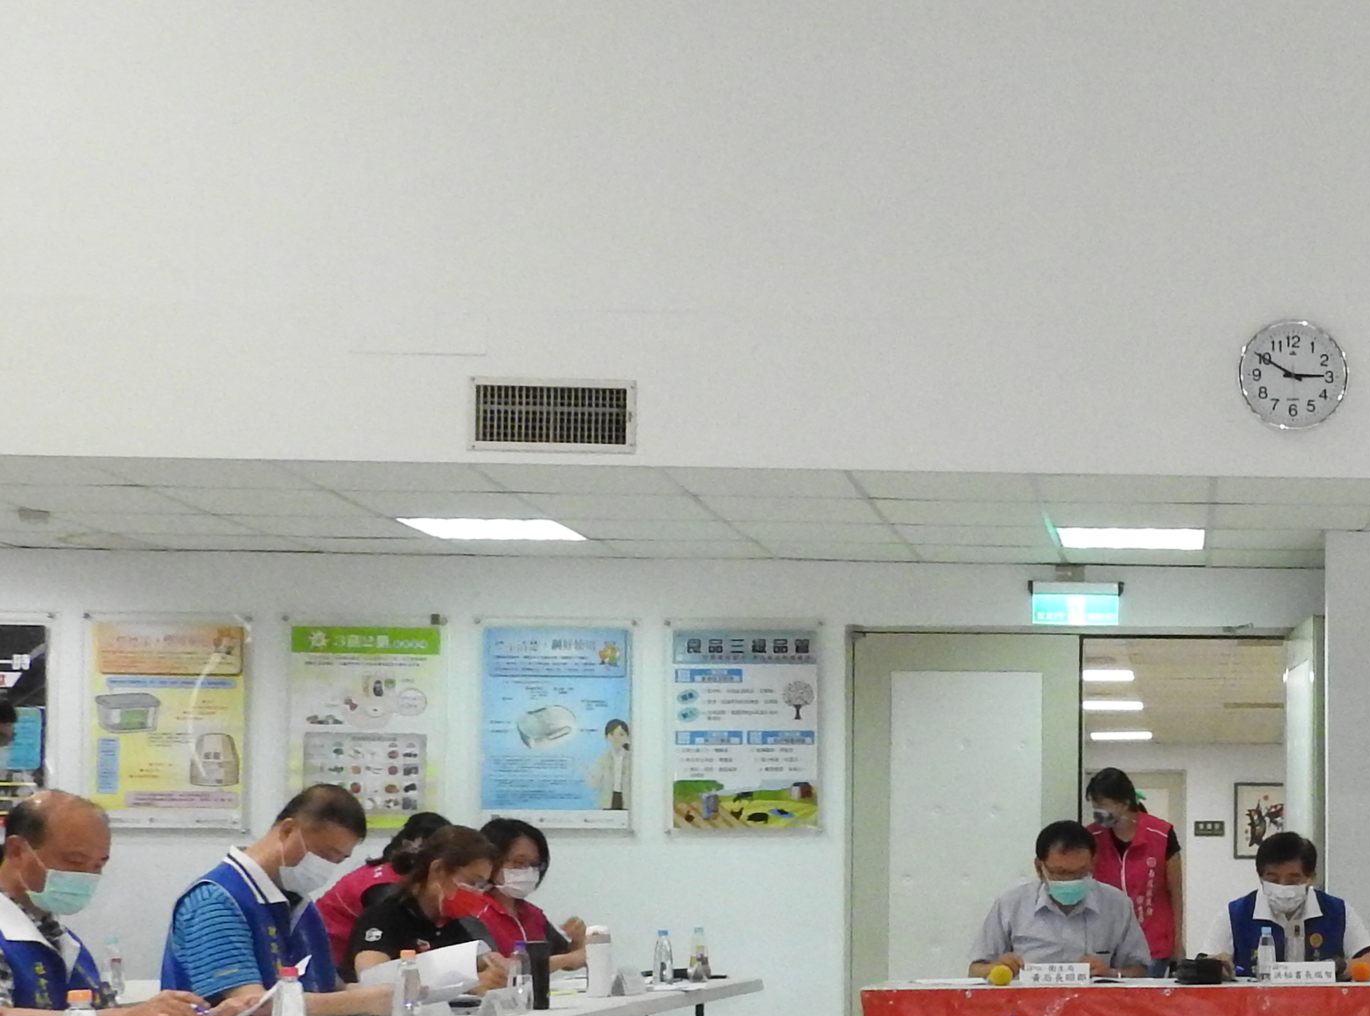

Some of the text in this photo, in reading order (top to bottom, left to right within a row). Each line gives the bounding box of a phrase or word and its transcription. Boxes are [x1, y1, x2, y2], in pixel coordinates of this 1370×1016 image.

[1271, 340, 1282, 352] 11
[1286, 335, 1301, 348] 12
[1310, 341, 1315, 354] 1
[1258, 352, 1272, 365] 10
[1320, 354, 1329, 367] 2
[1252, 369, 1261, 381] 9
[1324, 370, 1334, 383] 3
[1258, 386, 1268, 399] 8
[1319, 389, 1328, 400] 4
[1270, 399, 1279, 411] 7
[1288, 404, 1298, 417] 6
[1307, 399, 1316, 412] 5
